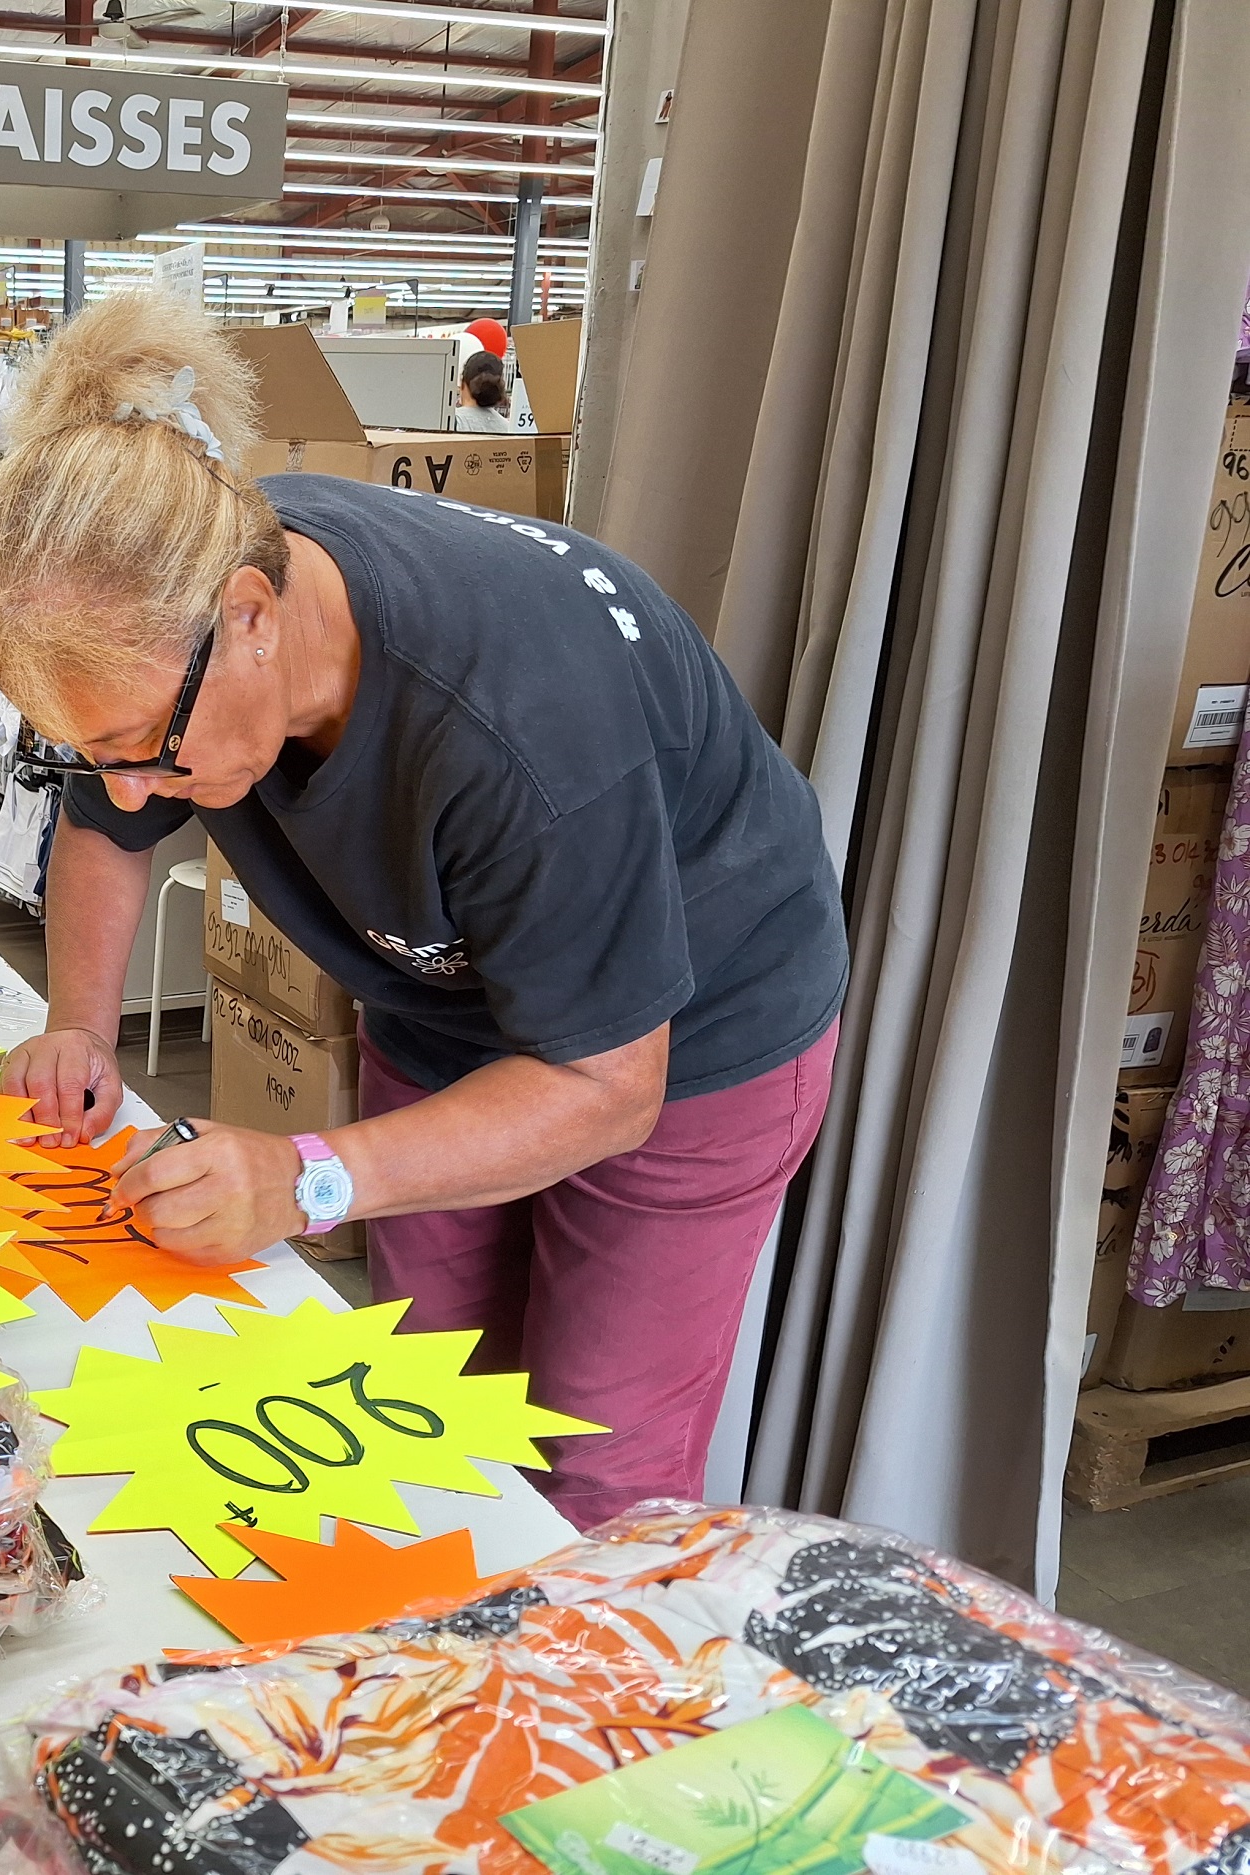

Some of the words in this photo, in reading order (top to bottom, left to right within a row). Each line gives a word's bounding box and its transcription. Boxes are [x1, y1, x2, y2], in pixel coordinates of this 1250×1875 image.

[391, 456, 412, 490] 9
[424, 454, 454, 494] A
[186, 1361, 445, 1494] 200
